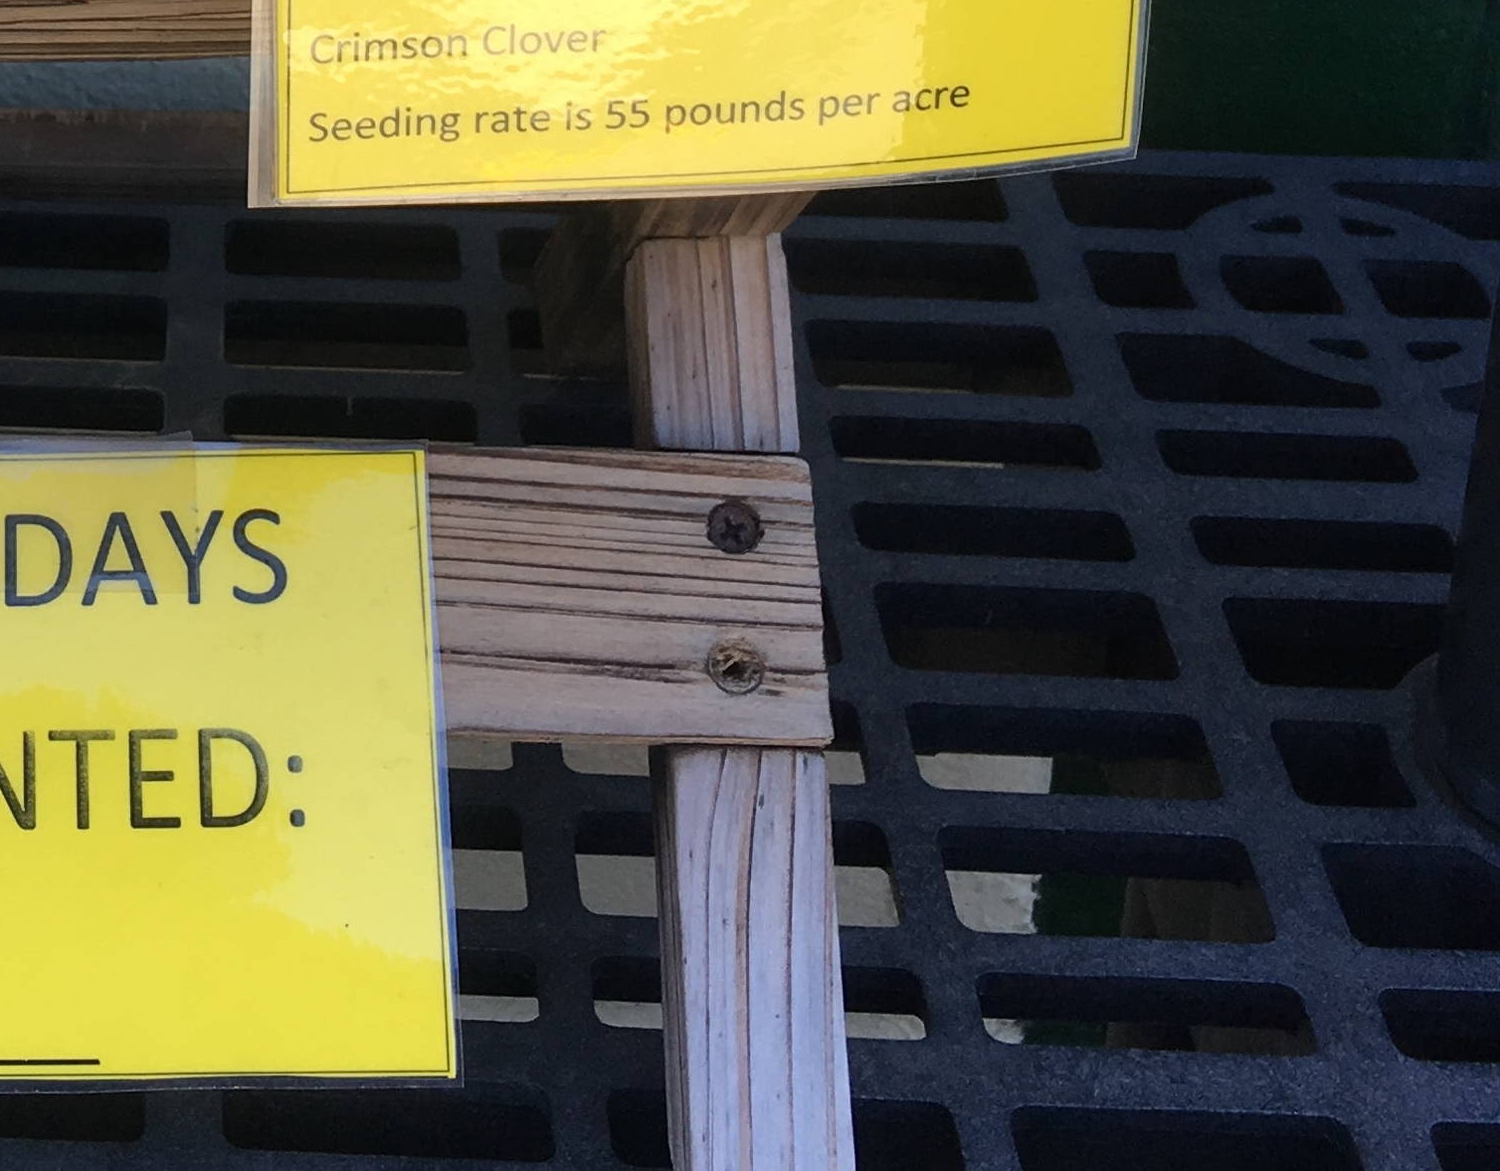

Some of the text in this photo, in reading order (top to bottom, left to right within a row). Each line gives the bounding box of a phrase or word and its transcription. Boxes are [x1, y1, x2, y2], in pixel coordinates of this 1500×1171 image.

[309, 23, 606, 67] Crimson Clover
[307, 81, 971, 144] Seeding rate is 55 pounds per acre
[3, 507, 289, 611] DAYS
